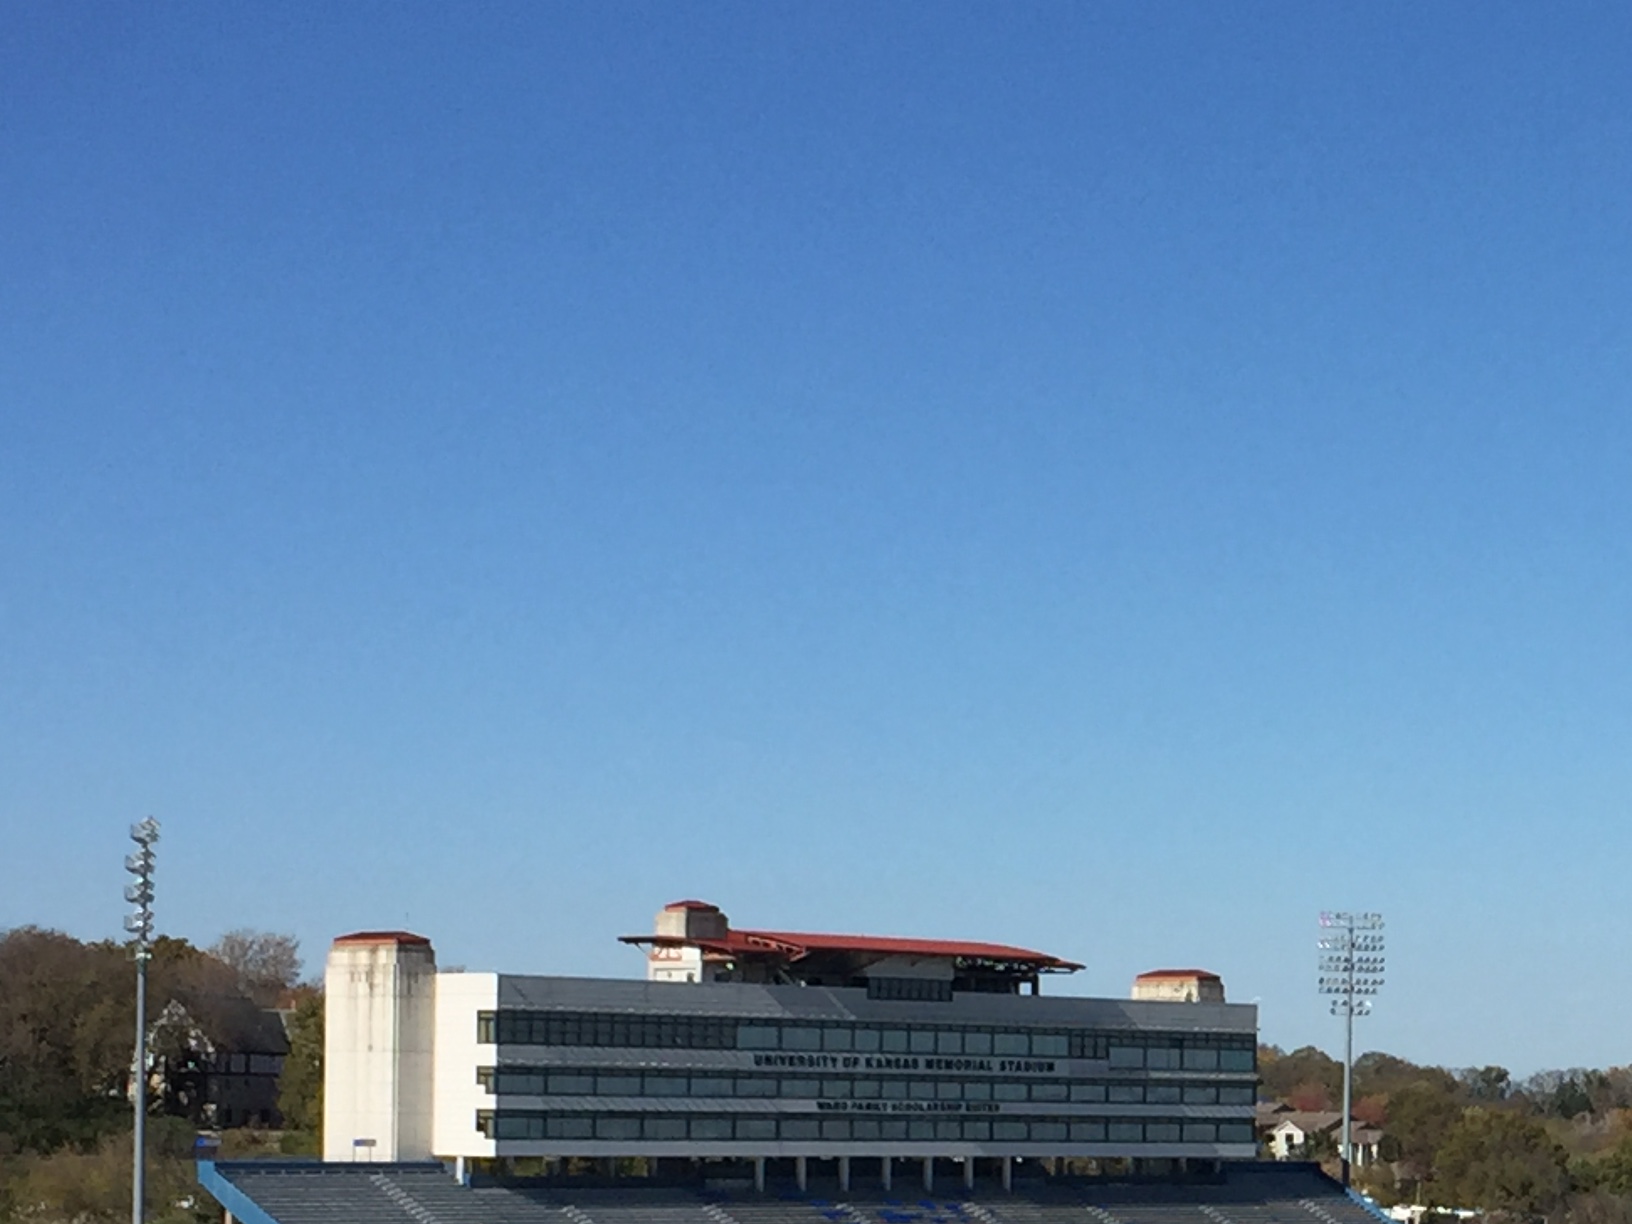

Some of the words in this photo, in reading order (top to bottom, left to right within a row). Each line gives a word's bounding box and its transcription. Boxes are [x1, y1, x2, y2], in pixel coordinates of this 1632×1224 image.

[753, 1054, 838, 1068] UNIVERSITY
[843, 1056, 860, 1068] OF
[865, 1057, 919, 1069] KANSAS
[925, 1059, 993, 1071] MEMORIAL
[1000, 1060, 1056, 1072] STADIUM
